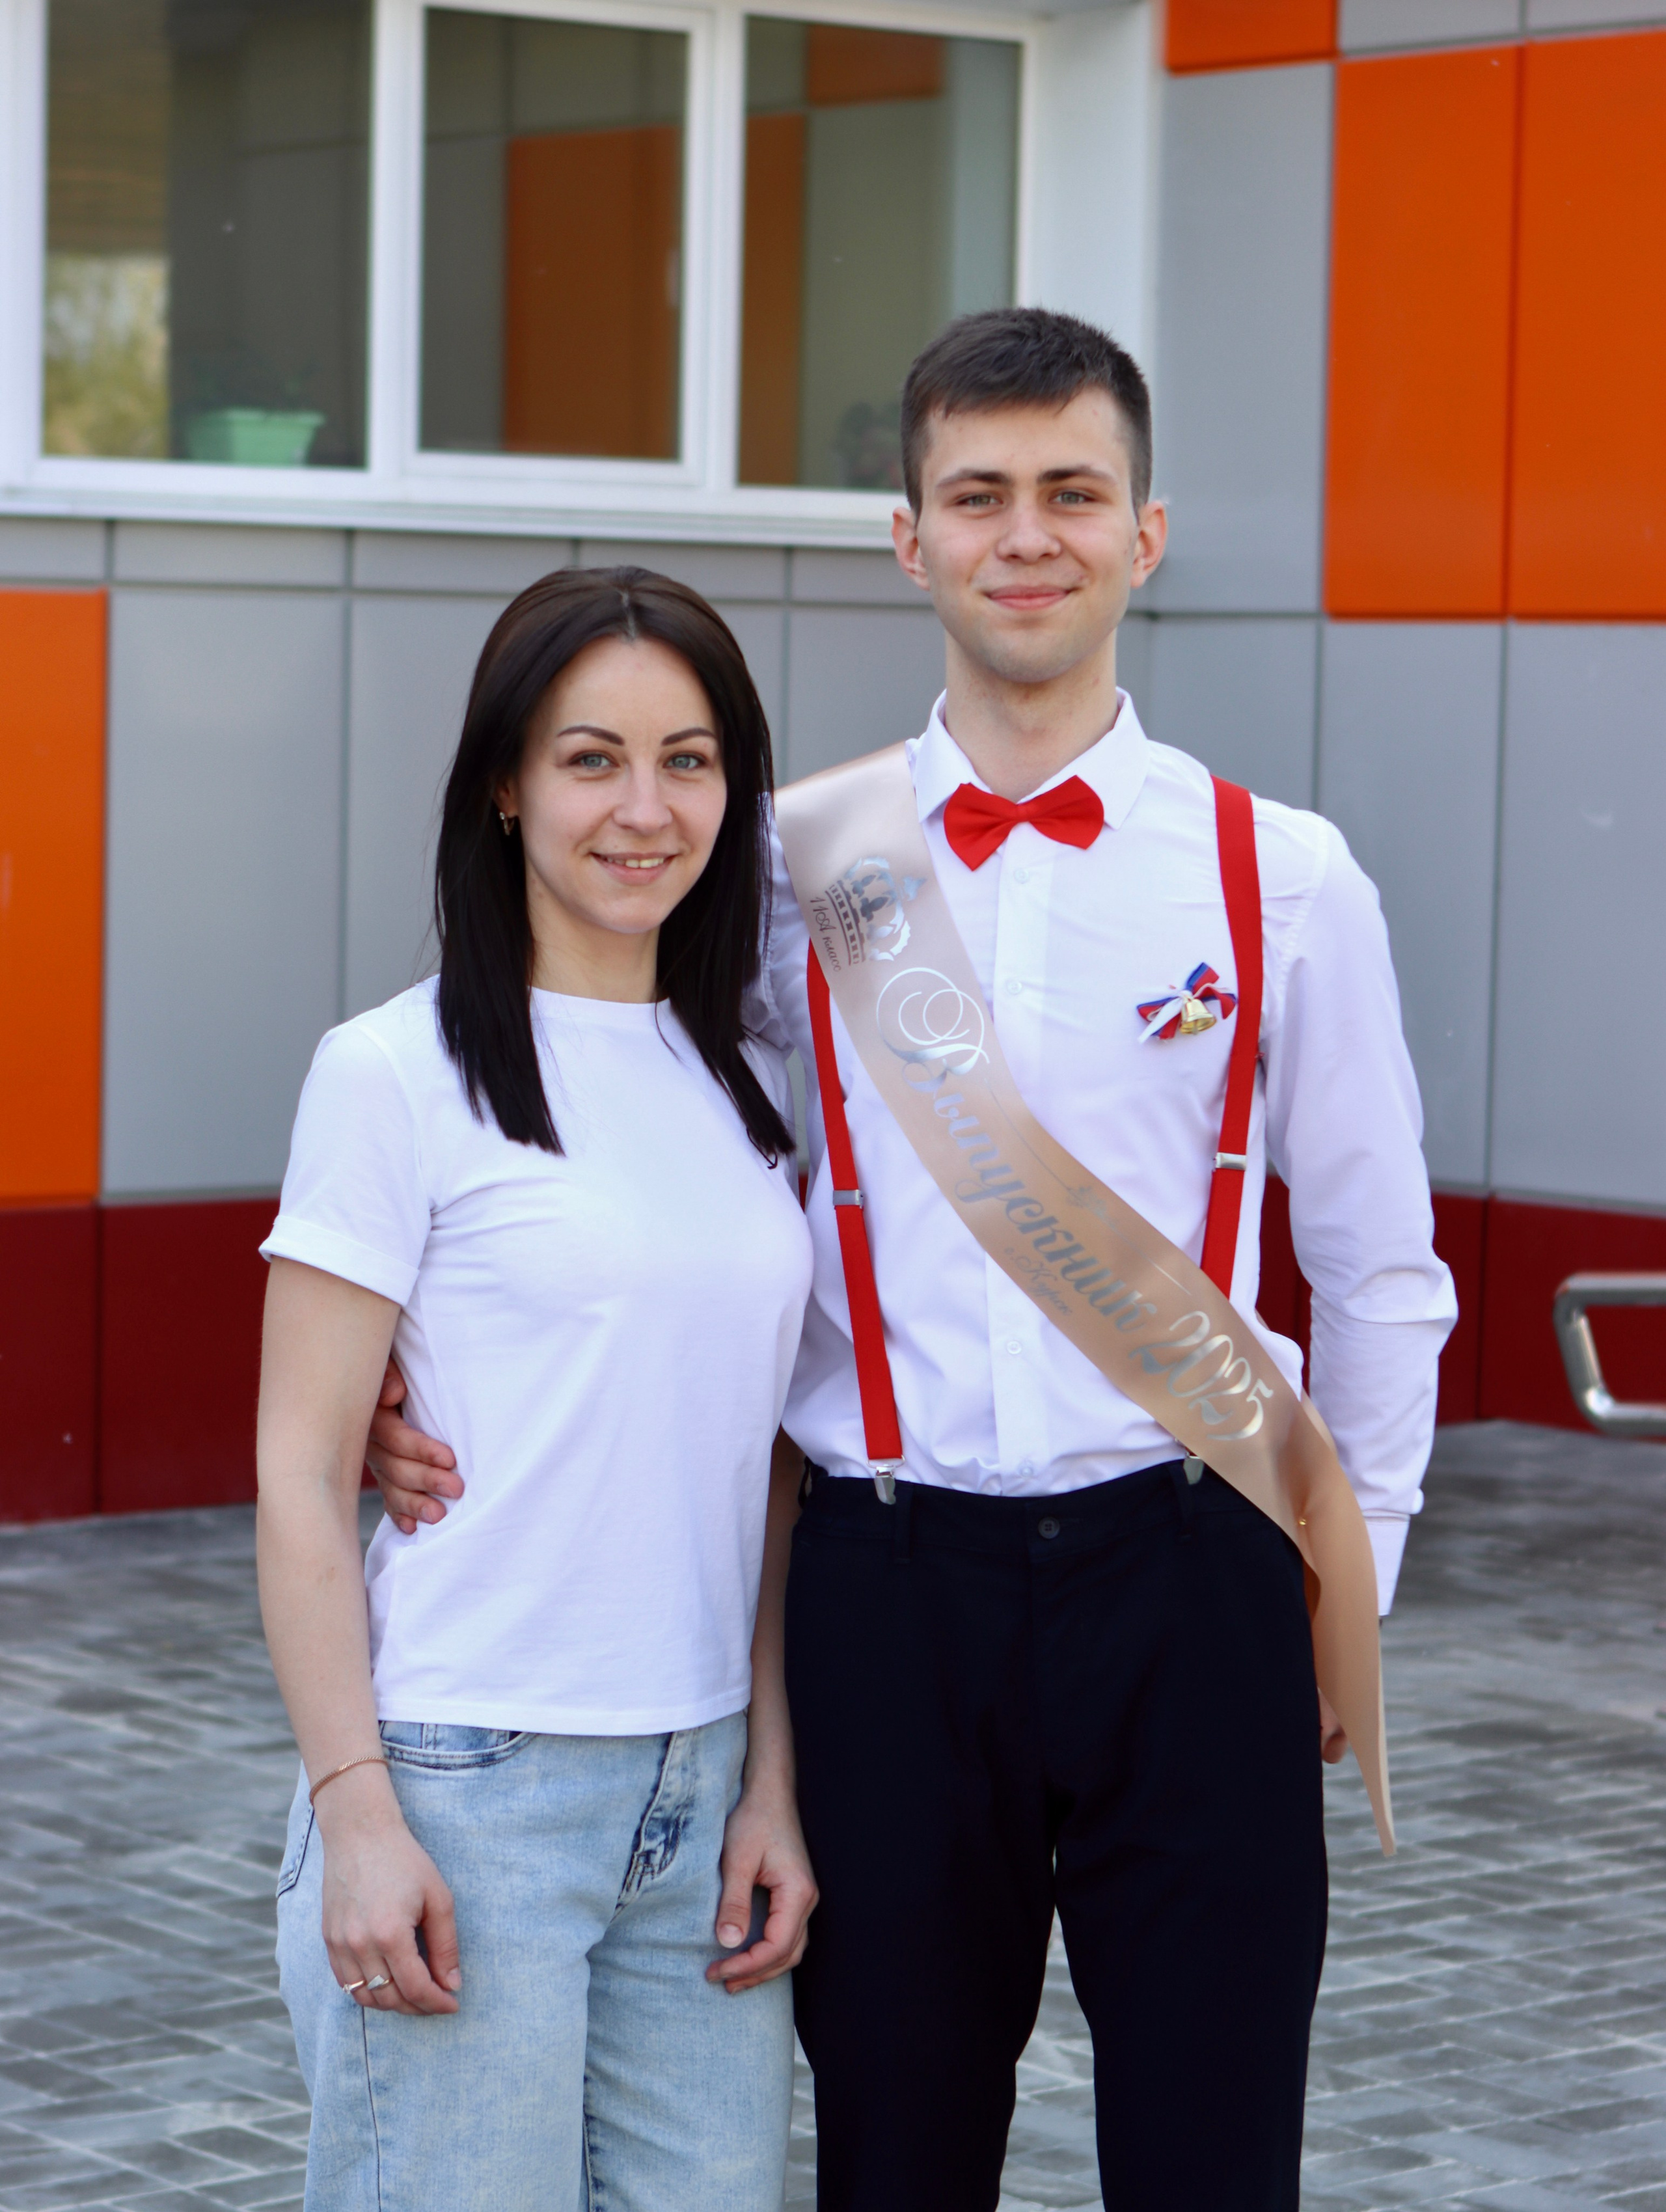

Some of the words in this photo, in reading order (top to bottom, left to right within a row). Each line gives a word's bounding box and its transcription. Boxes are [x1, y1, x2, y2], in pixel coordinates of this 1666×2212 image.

[823, 936, 842, 973] класс
[875, 966, 1158, 1333] Выпускник
[1127, 1310, 1274, 1441] 2025
